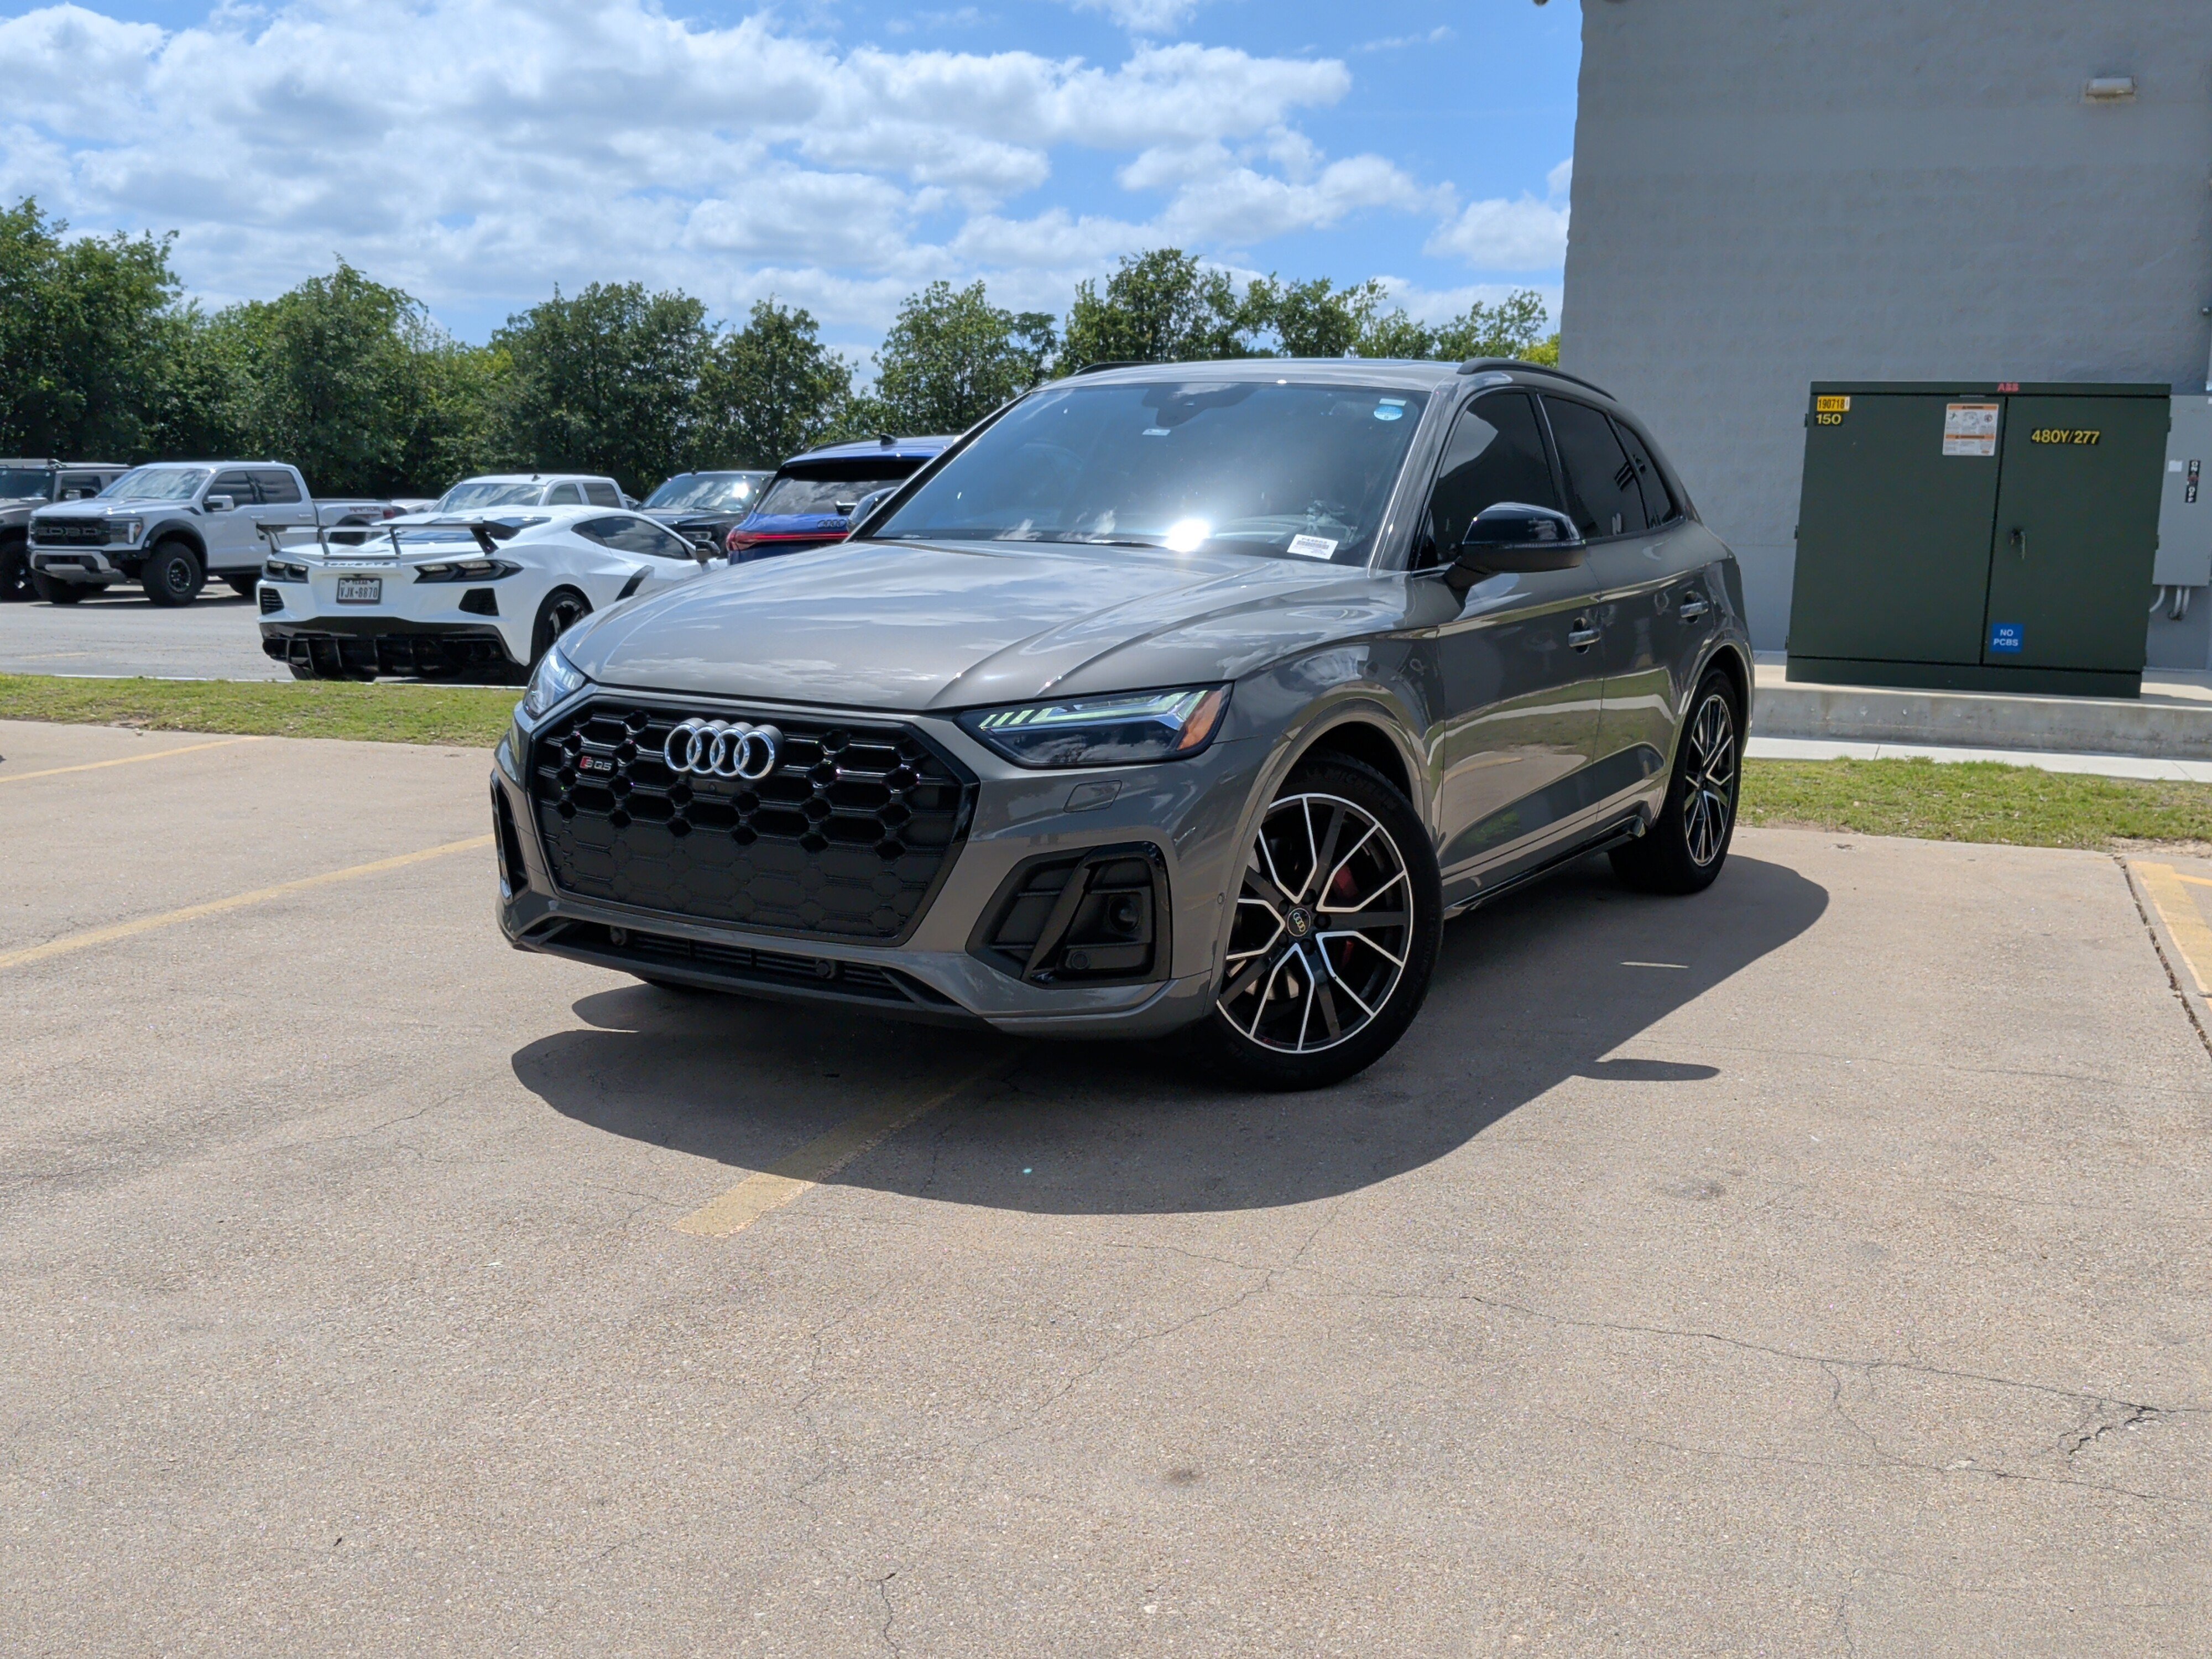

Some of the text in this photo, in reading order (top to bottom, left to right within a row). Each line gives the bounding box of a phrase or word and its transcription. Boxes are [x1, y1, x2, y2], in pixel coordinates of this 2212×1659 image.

[1997, 383, 2020, 392] ABB
[1818, 399, 1845, 409] 190718
[1816, 414, 1841, 425] 150
[2032, 430, 2100, 445] 480Y/277
[1993, 638, 2018, 646] PCBS
